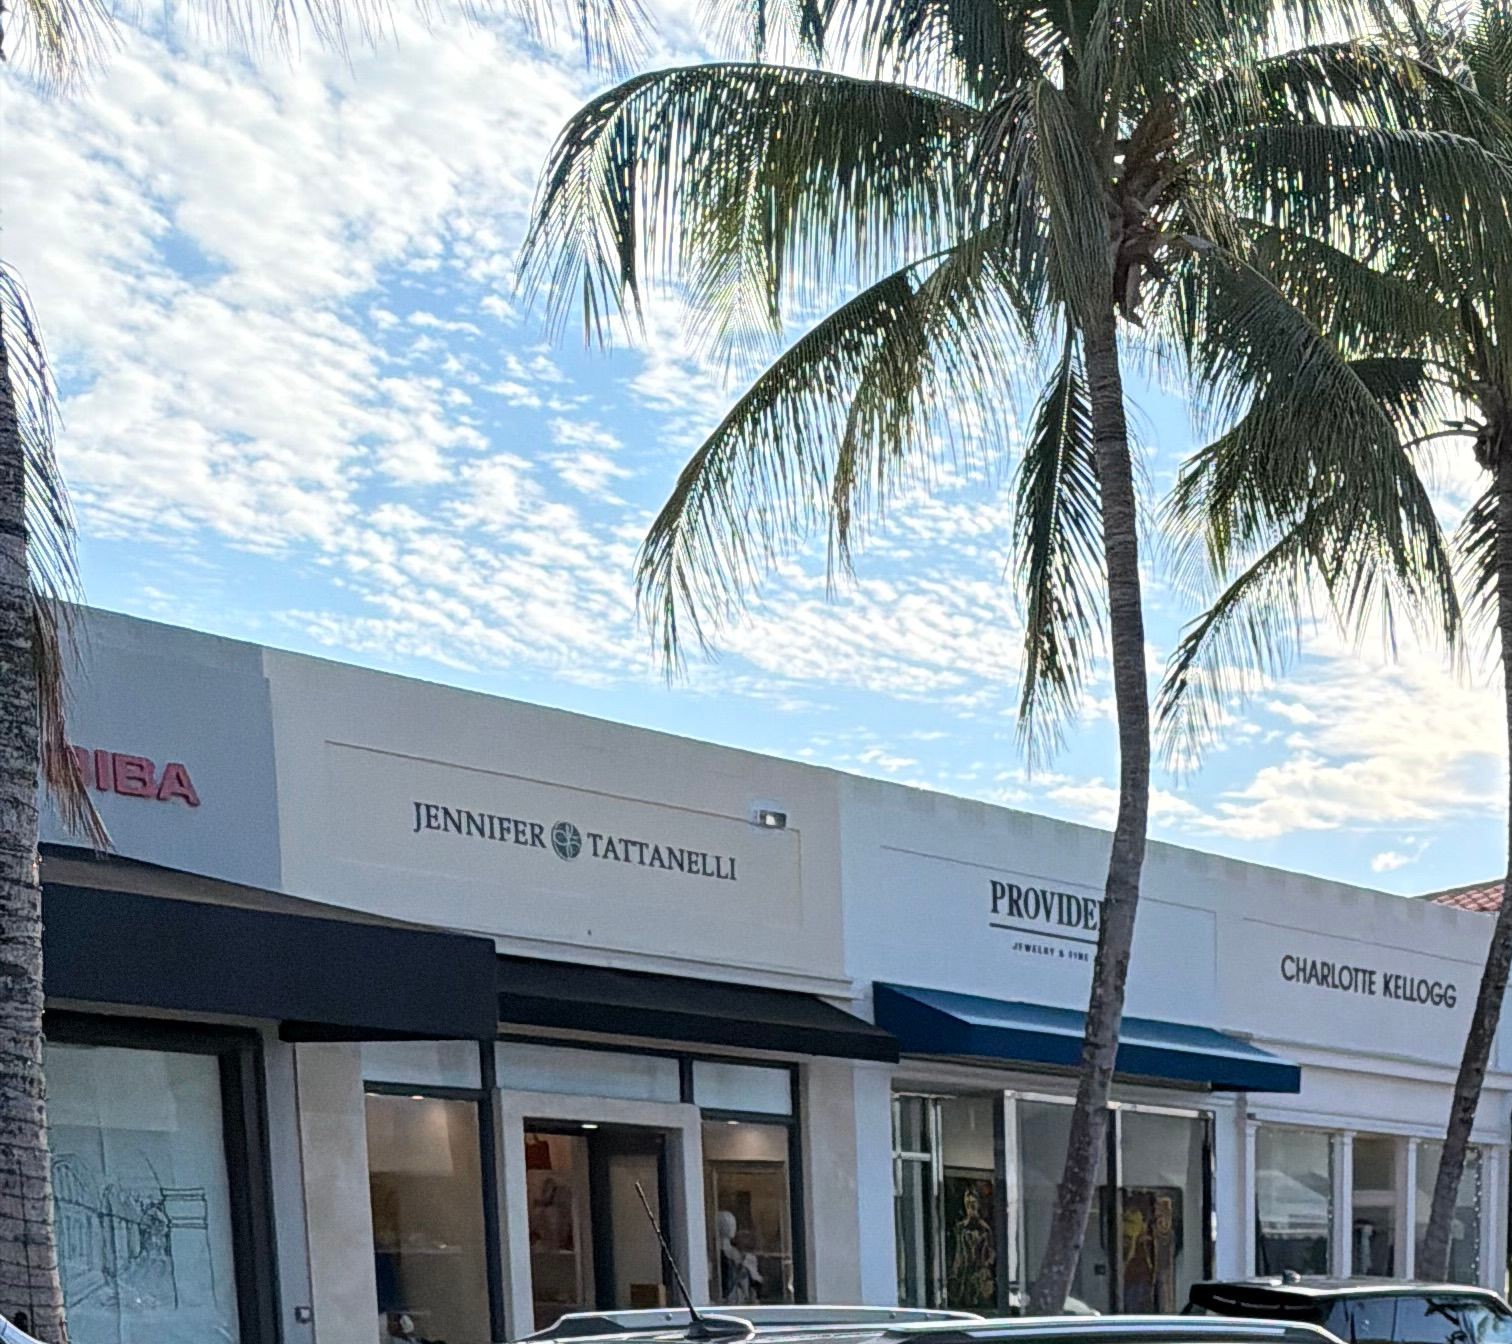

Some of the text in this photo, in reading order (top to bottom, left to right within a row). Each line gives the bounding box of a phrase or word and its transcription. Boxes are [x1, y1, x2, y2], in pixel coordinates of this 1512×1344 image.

[413, 801, 737, 881] JENNIFER TATTANELLI
[989, 879, 1101, 931] PROVIDE
[1281, 954, 1458, 1009] CHARLOTTE KELLOGG
